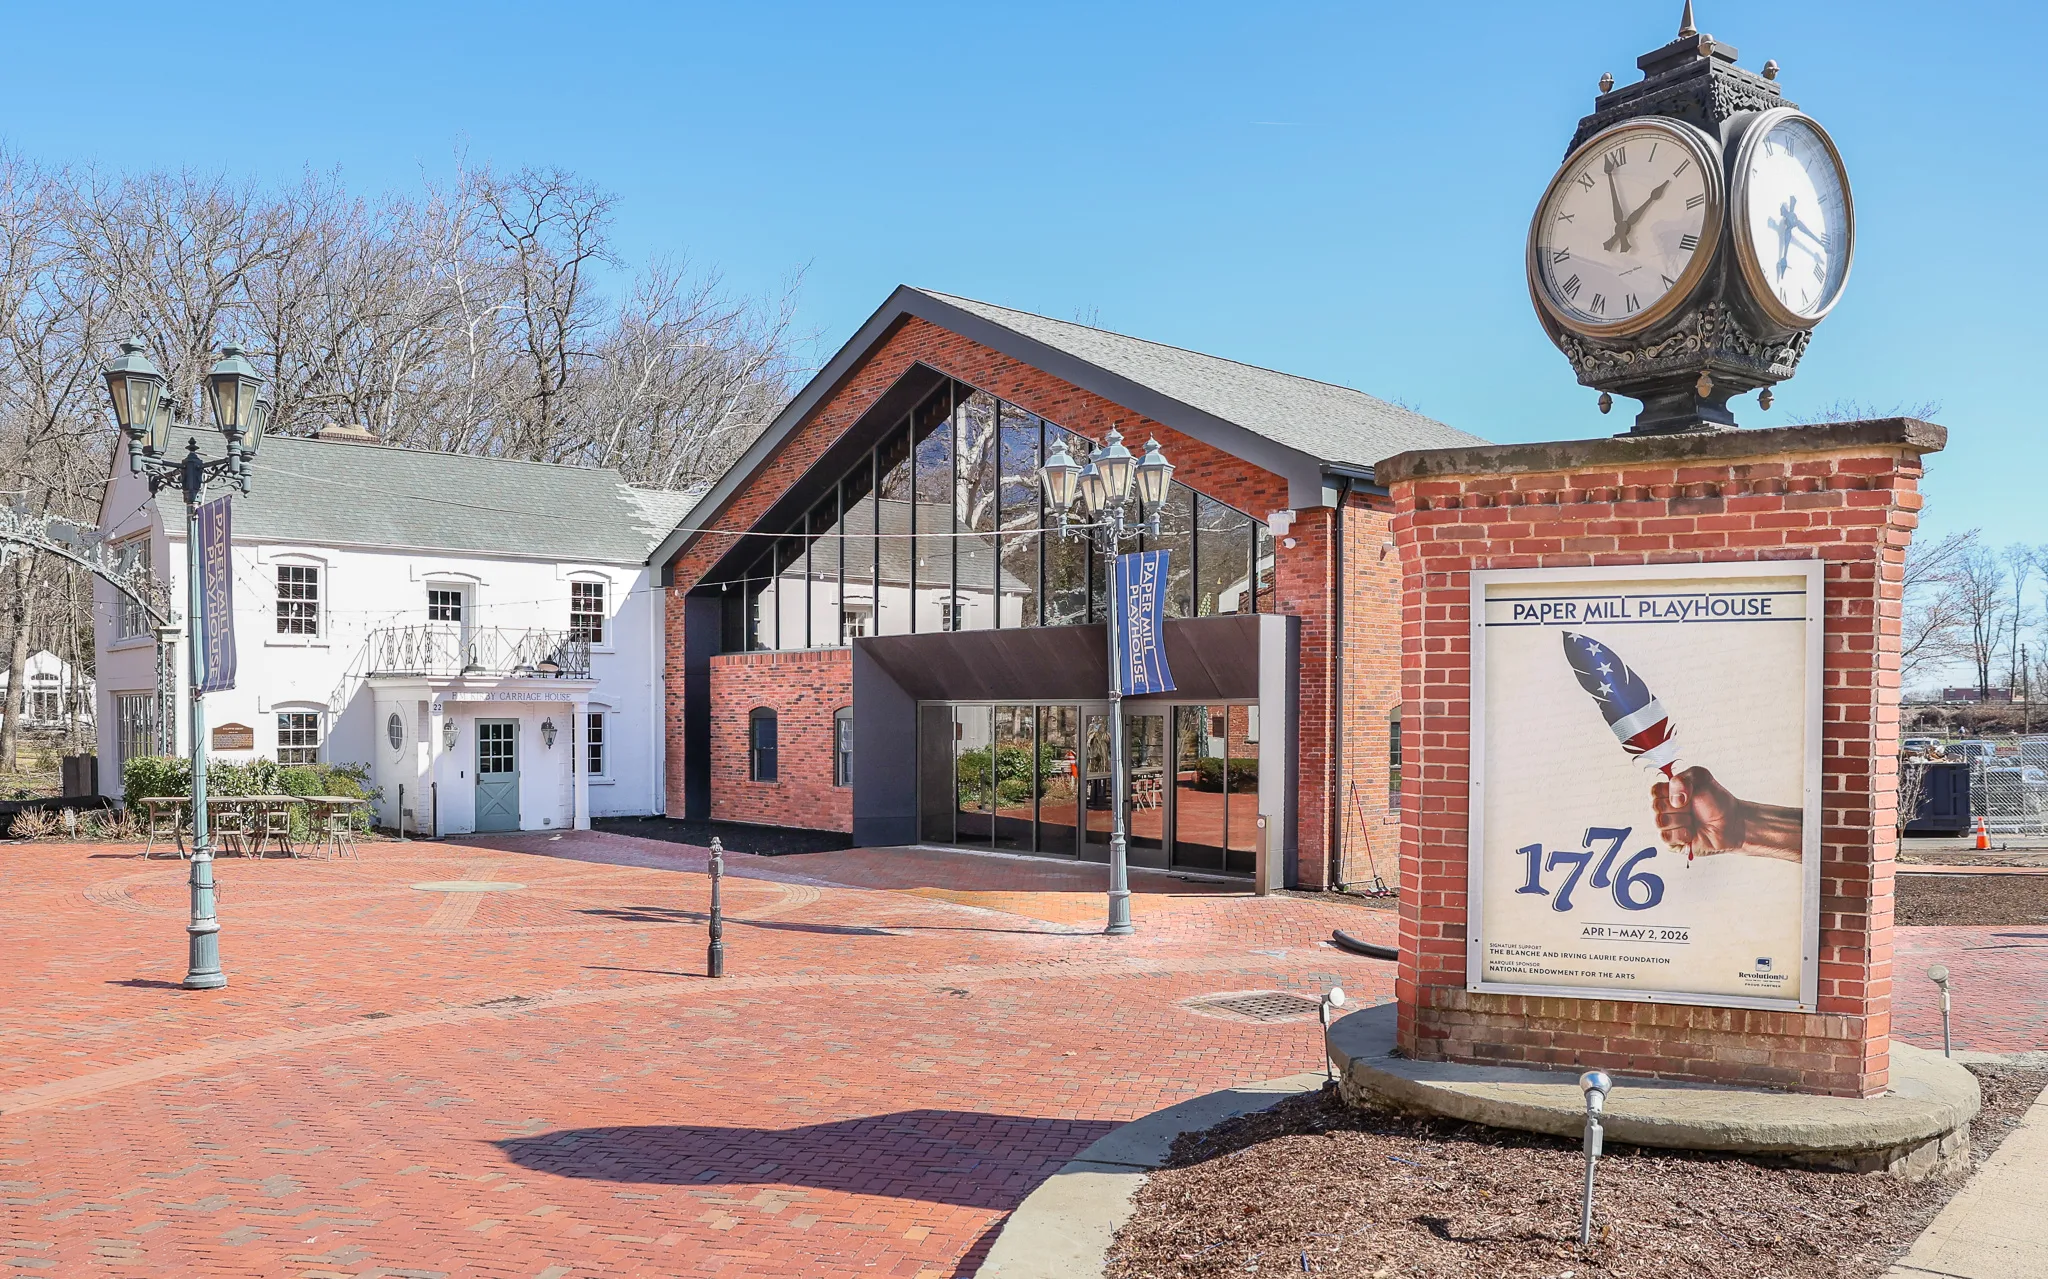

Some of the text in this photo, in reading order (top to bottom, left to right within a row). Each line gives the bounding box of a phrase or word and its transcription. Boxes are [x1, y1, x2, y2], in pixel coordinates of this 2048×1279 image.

[1673, 158, 1691, 178] II
[1577, 172, 1596, 193] XI
[1686, 193, 1705, 210] III
[1558, 211, 1575, 224] X
[215, 513, 230, 640] PAPER MILL
[207, 546, 219, 679] PLAYHOUSE
[1140, 562, 1156, 655] PAPER MILL
[1513, 595, 1773, 623] PAPER MILL PLAYHOUSE
[1129, 585, 1145, 684] PLAYHOUSE
[500, 691, 541, 701] CARRIAGE
[544, 692, 572, 701] HOUSE
[433, 703, 442, 711] 22
[1515, 826, 1665, 912] 1776
[1582, 926, 1604, 937] APR
[1648, 930, 1657, 940] 2,
[1660, 930, 1689, 941] 2026
[1506, 949, 1541, 957] BLANCHE
[1560, 952, 1587, 960] IRVING
[1618, 956, 1671, 964] FOUNDATION
[1489, 965, 1527, 974] NATIONAL
[1529, 967, 1580, 976] ENDOWMENT
